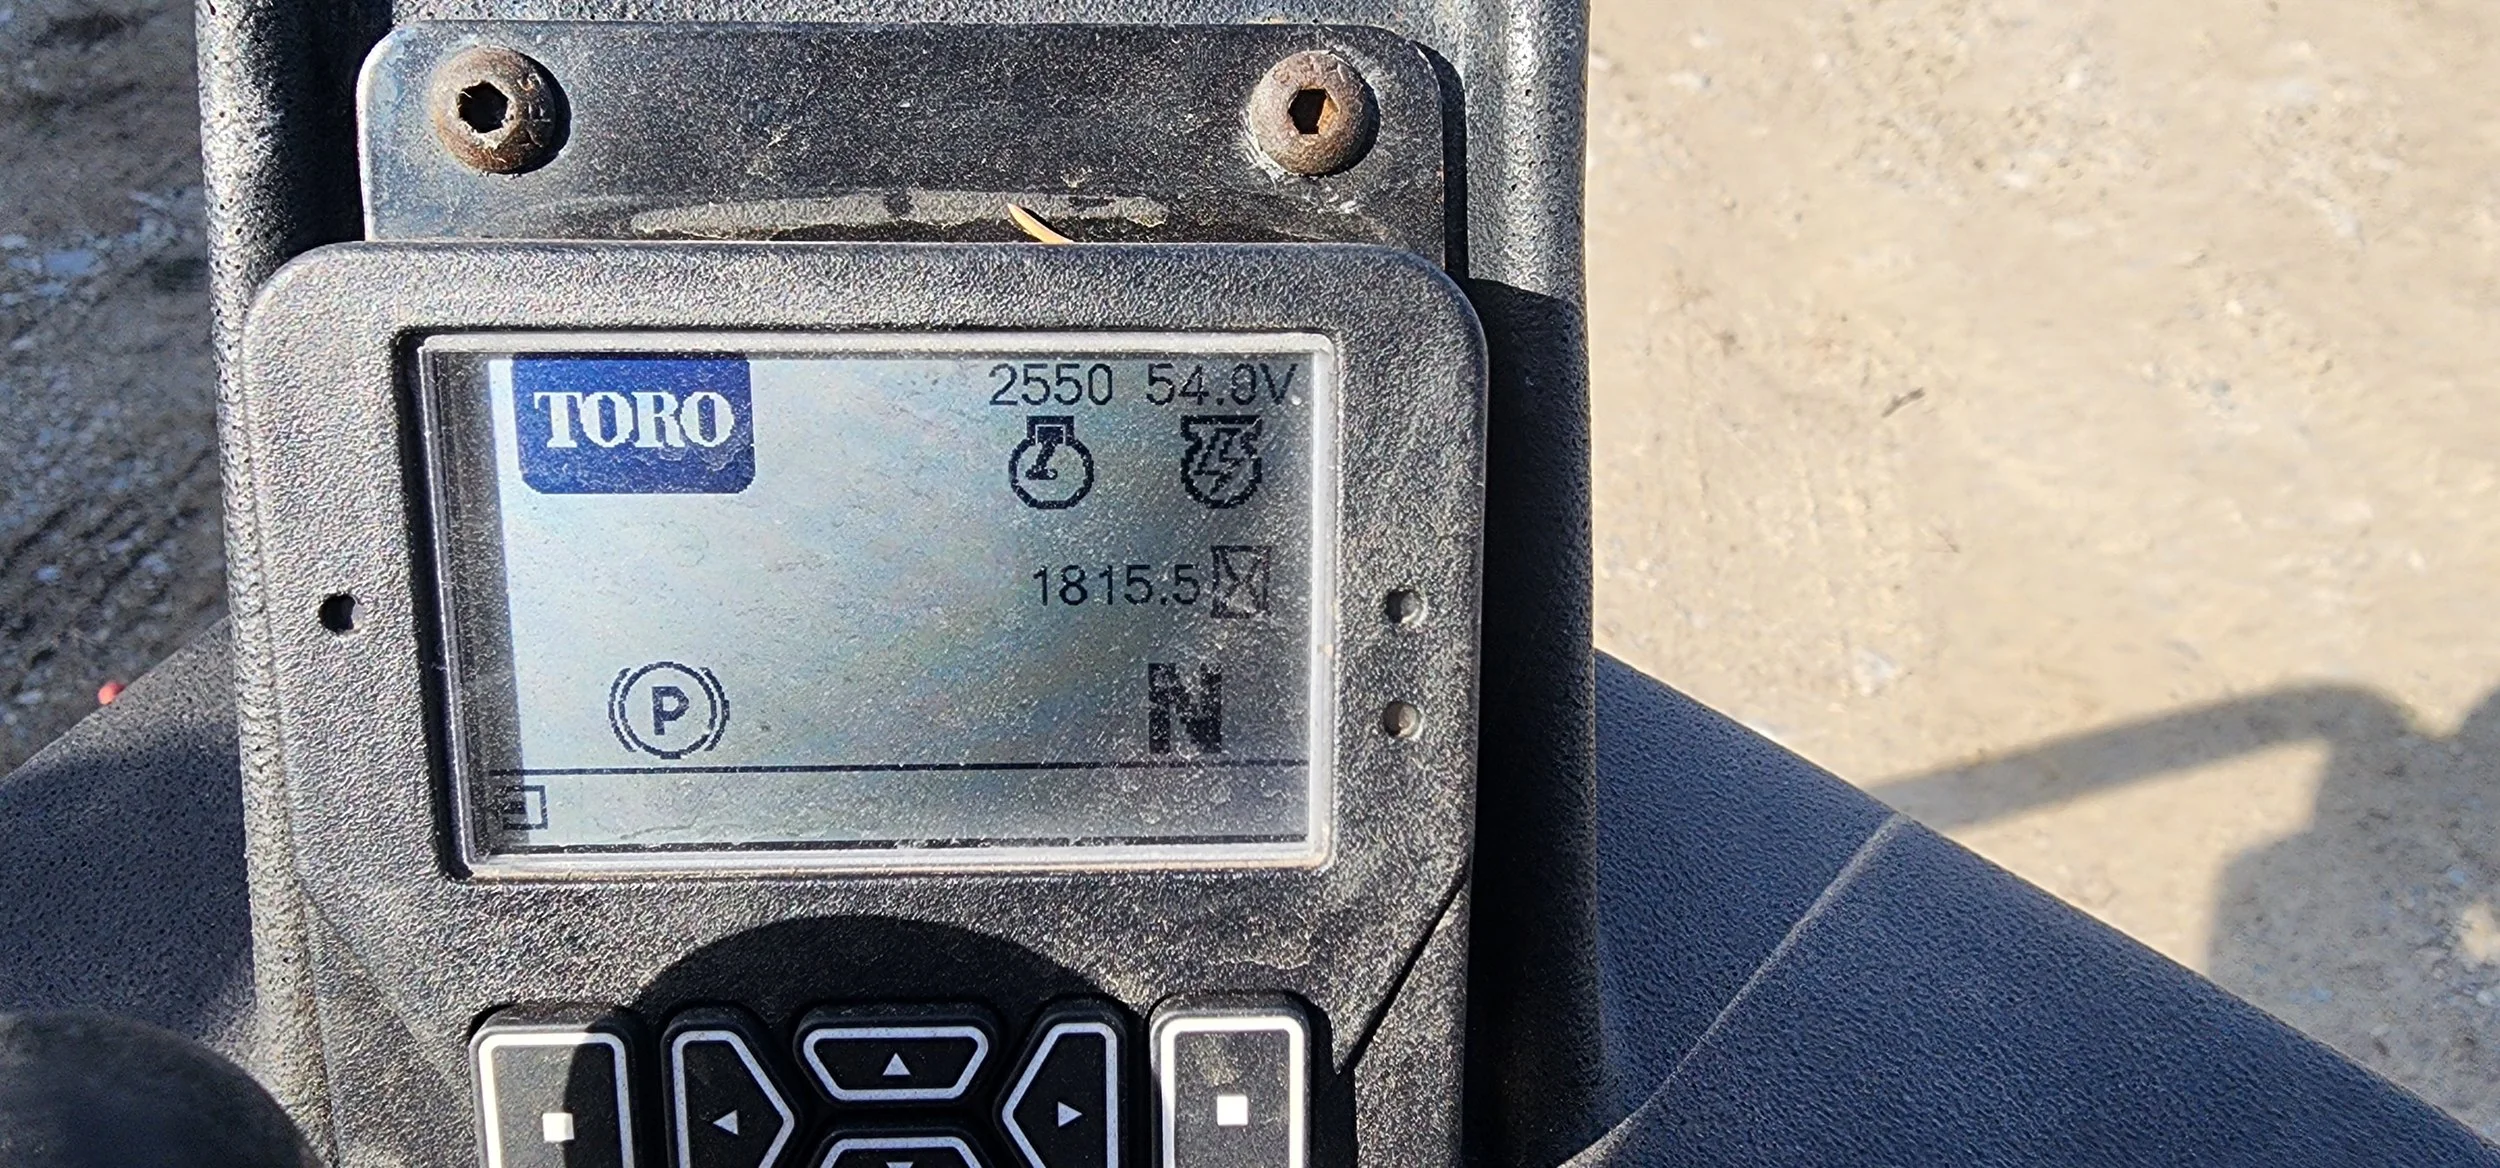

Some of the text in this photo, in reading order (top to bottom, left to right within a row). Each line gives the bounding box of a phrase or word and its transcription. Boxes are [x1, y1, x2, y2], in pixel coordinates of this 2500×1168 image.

[988, 363, 1113, 406] 2550
[533, 391, 736, 447] TORO
[1033, 564, 1200, 606] 1815.5
[652, 686, 690, 736] P
[1148, 662, 1222, 753] N
